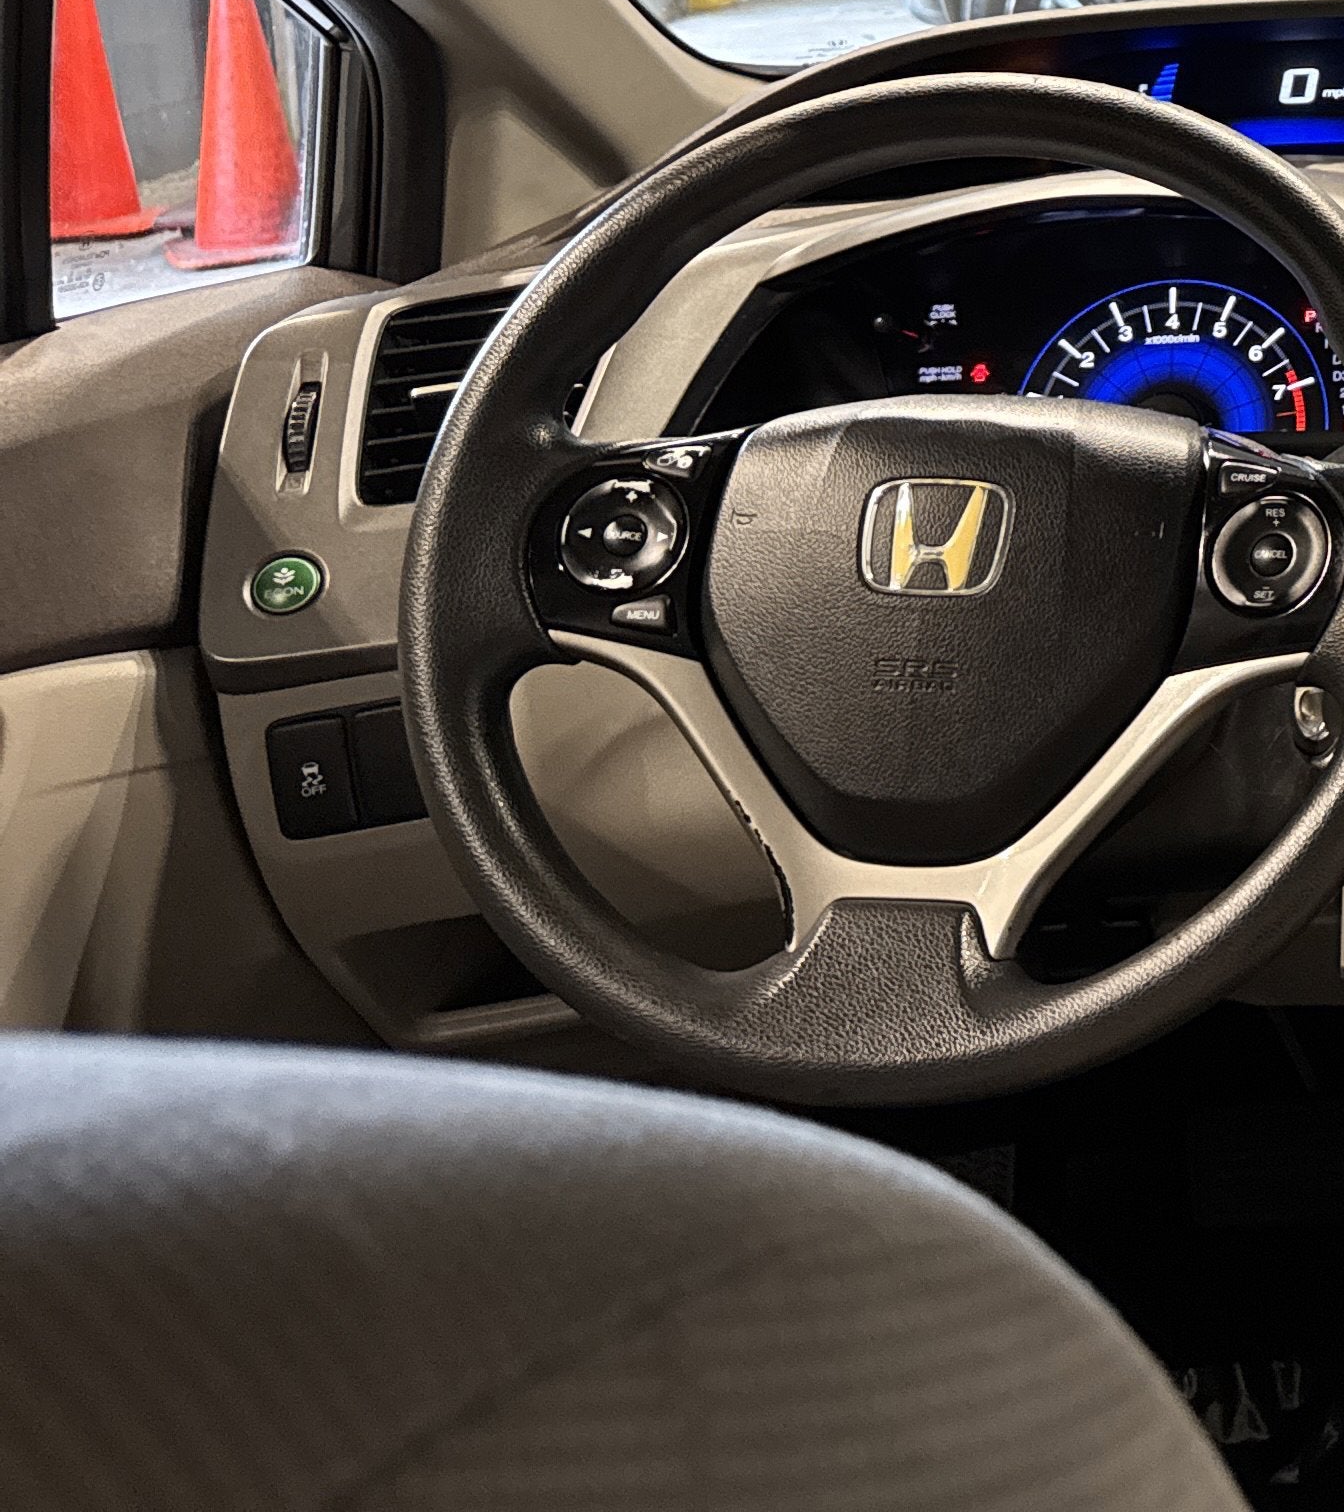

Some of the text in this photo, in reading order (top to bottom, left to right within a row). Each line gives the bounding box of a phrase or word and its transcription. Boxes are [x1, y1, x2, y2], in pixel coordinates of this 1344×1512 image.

[1278, 67, 1320, 105] 0
[1165, 314, 1181, 330] 4
[1304, 309, 1317, 323] P
[1117, 325, 1134, 342] 3
[1212, 321, 1229, 338] 5
[1078, 351, 1095, 369] 2
[1248, 344, 1264, 362] 6
[1271, 384, 1288, 401] 7
[1230, 473, 1267, 483] CRUISE
[1265, 508, 1286, 518] RES
[1254, 549, 1288, 559] CANCEL
[1253, 590, 1275, 600] SET
[626, 609, 660, 620] MENU
[301, 783, 327, 798] OFF
